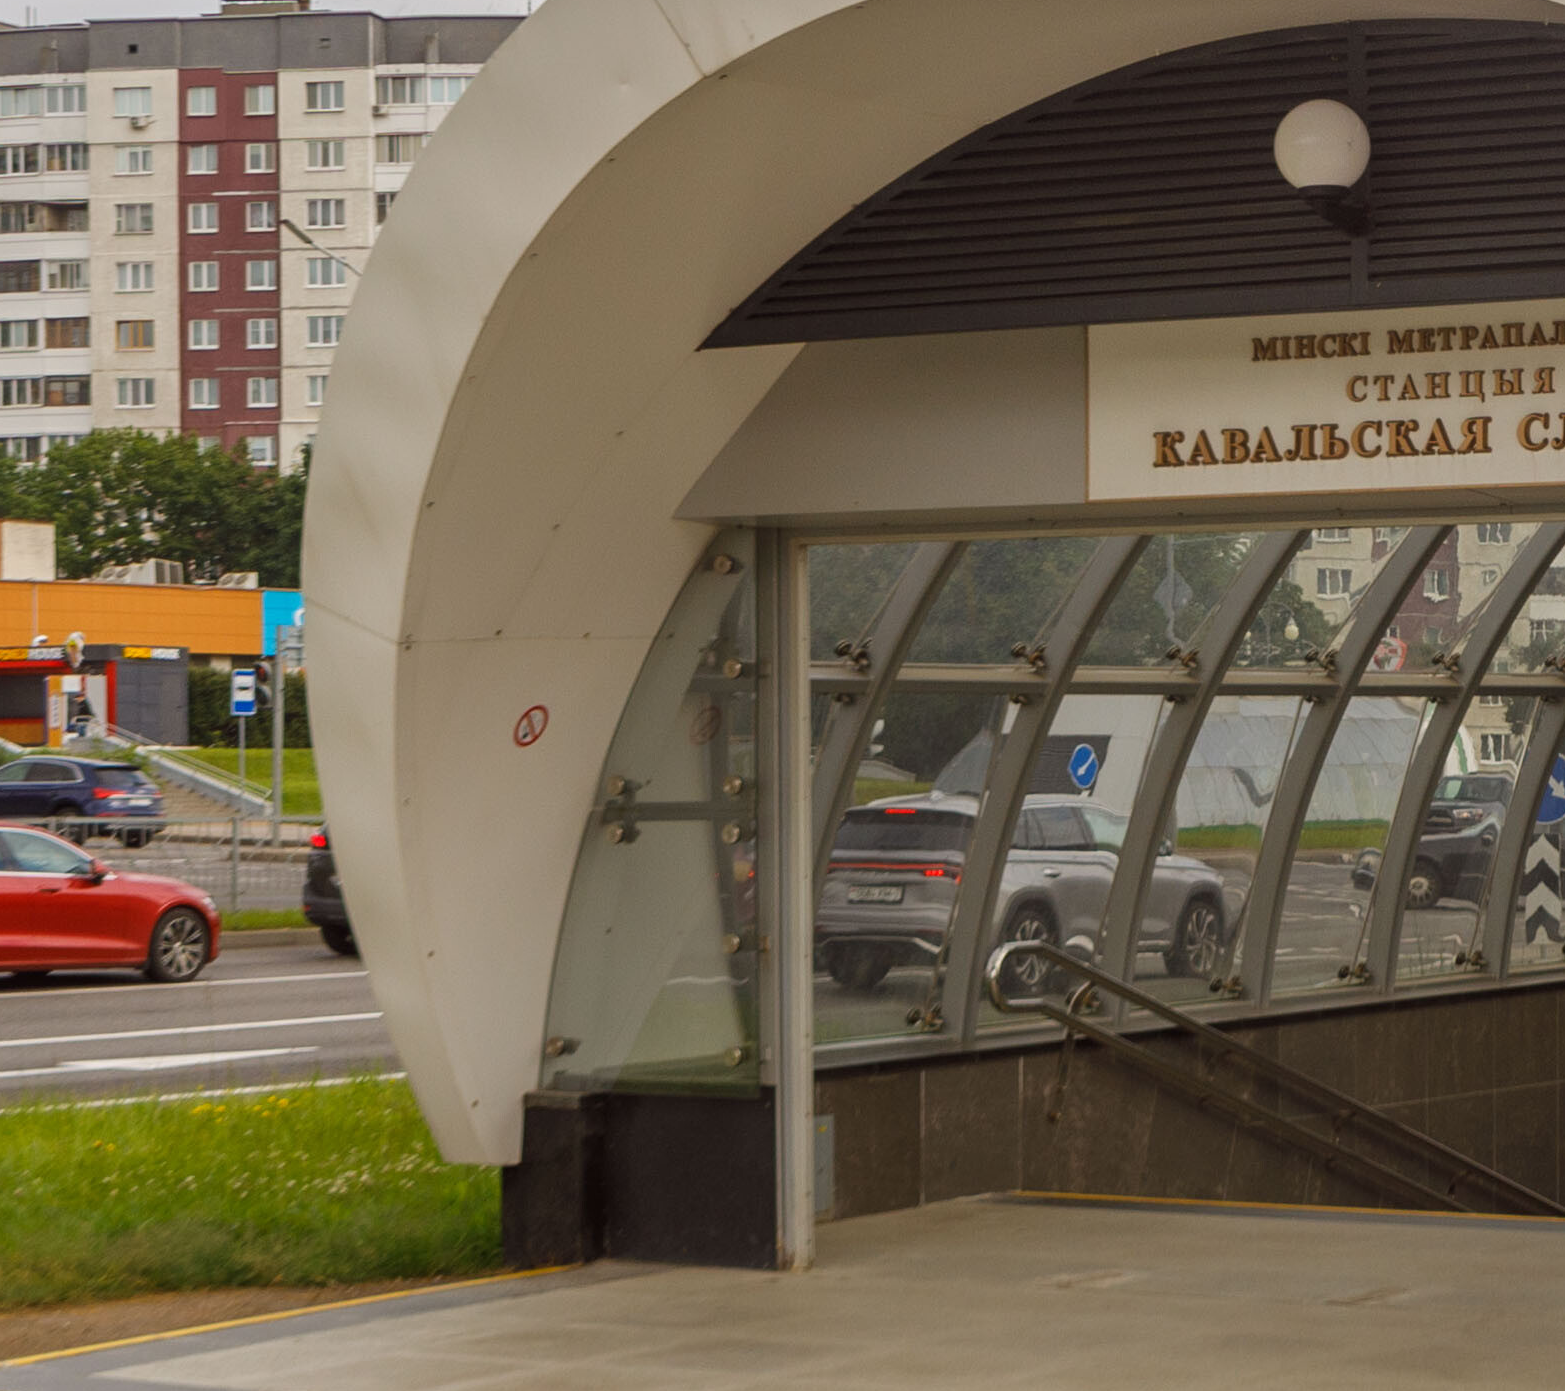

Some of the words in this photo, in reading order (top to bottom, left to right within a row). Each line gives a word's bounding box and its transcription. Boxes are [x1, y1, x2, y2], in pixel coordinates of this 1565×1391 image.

[1250, 331, 1372, 363] МІНСКІ
[1345, 366, 1557, 403] СТАНЦЫЯ
[1152, 414, 1493, 468] КАВАЛЬСКАЯ
